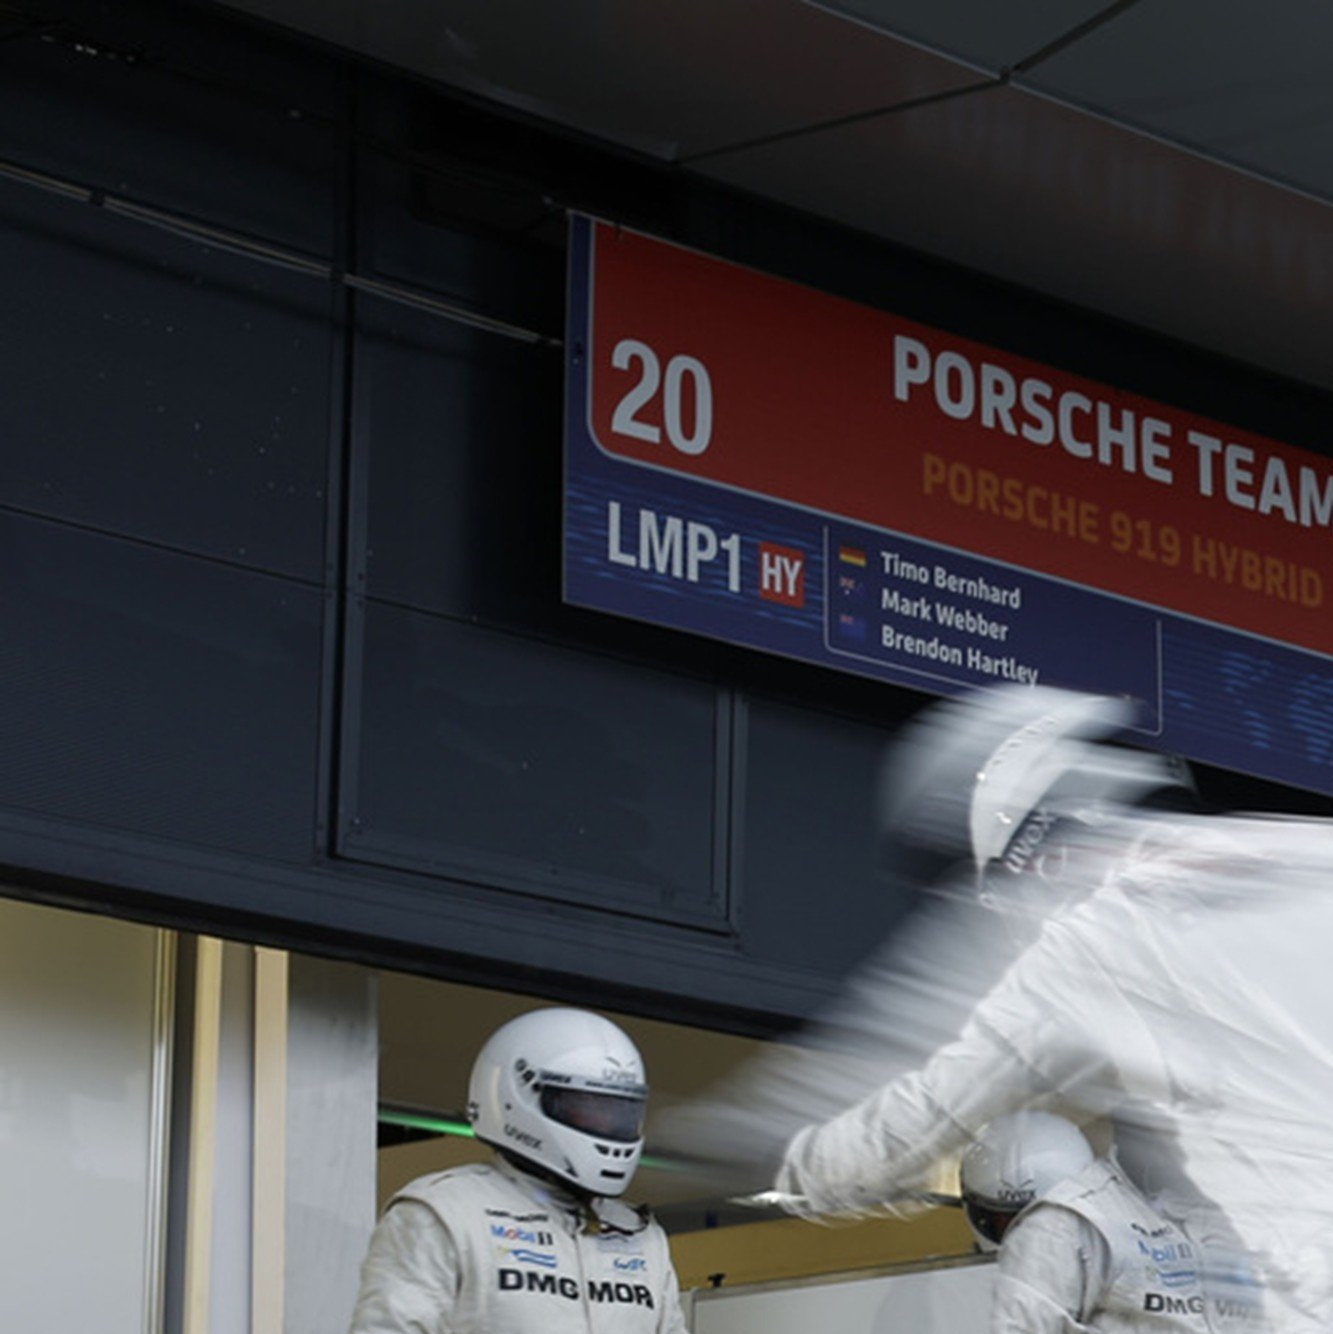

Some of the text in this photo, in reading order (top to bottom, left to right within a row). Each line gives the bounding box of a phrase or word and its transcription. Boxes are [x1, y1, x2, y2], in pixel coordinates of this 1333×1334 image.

[611, 338, 713, 456] 20
[894, 334, 1173, 485] PORSCHE
[607, 501, 803, 596] LMP1 HY
[923, 453, 1323, 608] PORSCHE 919 HYBRID
[881, 551, 1021, 610] Timo Bernhard
[881, 588, 1009, 642] Mark Webber
[881, 625, 1038, 689] Brendon Hartley
[498, 1268, 580, 1301] DMG
[1143, 1292, 1206, 1315] DMG
